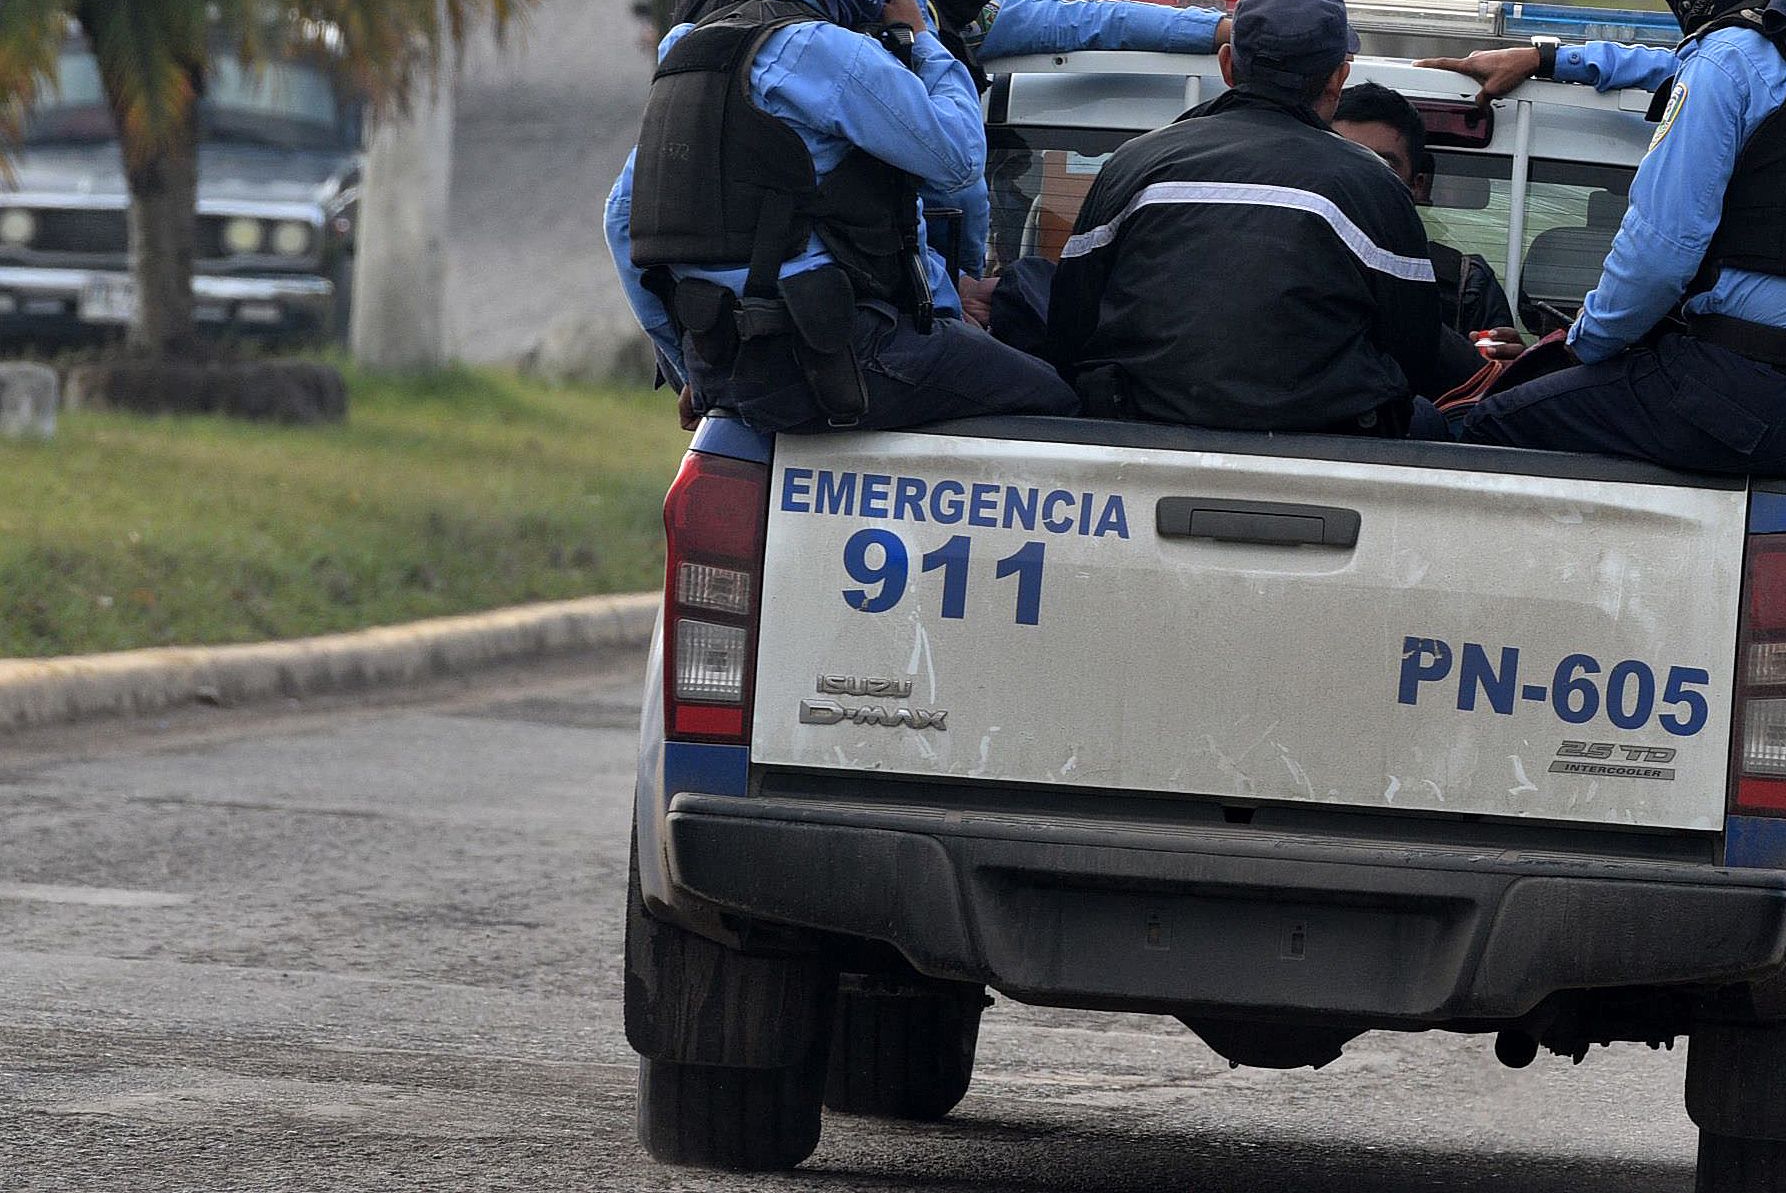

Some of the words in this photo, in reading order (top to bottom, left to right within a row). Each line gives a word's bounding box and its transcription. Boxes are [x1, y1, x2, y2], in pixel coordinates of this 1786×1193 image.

[781, 467, 1131, 539] EMERGENCIA
[842, 528, 1046, 626] 911
[816, 673, 912, 698] ISUZU
[1397, 635, 1710, 737] PN-605
[799, 698, 949, 731] D-MAX
[1564, 763, 1662, 777] INTERCOOLER
[1619, 744, 1676, 763] TD
